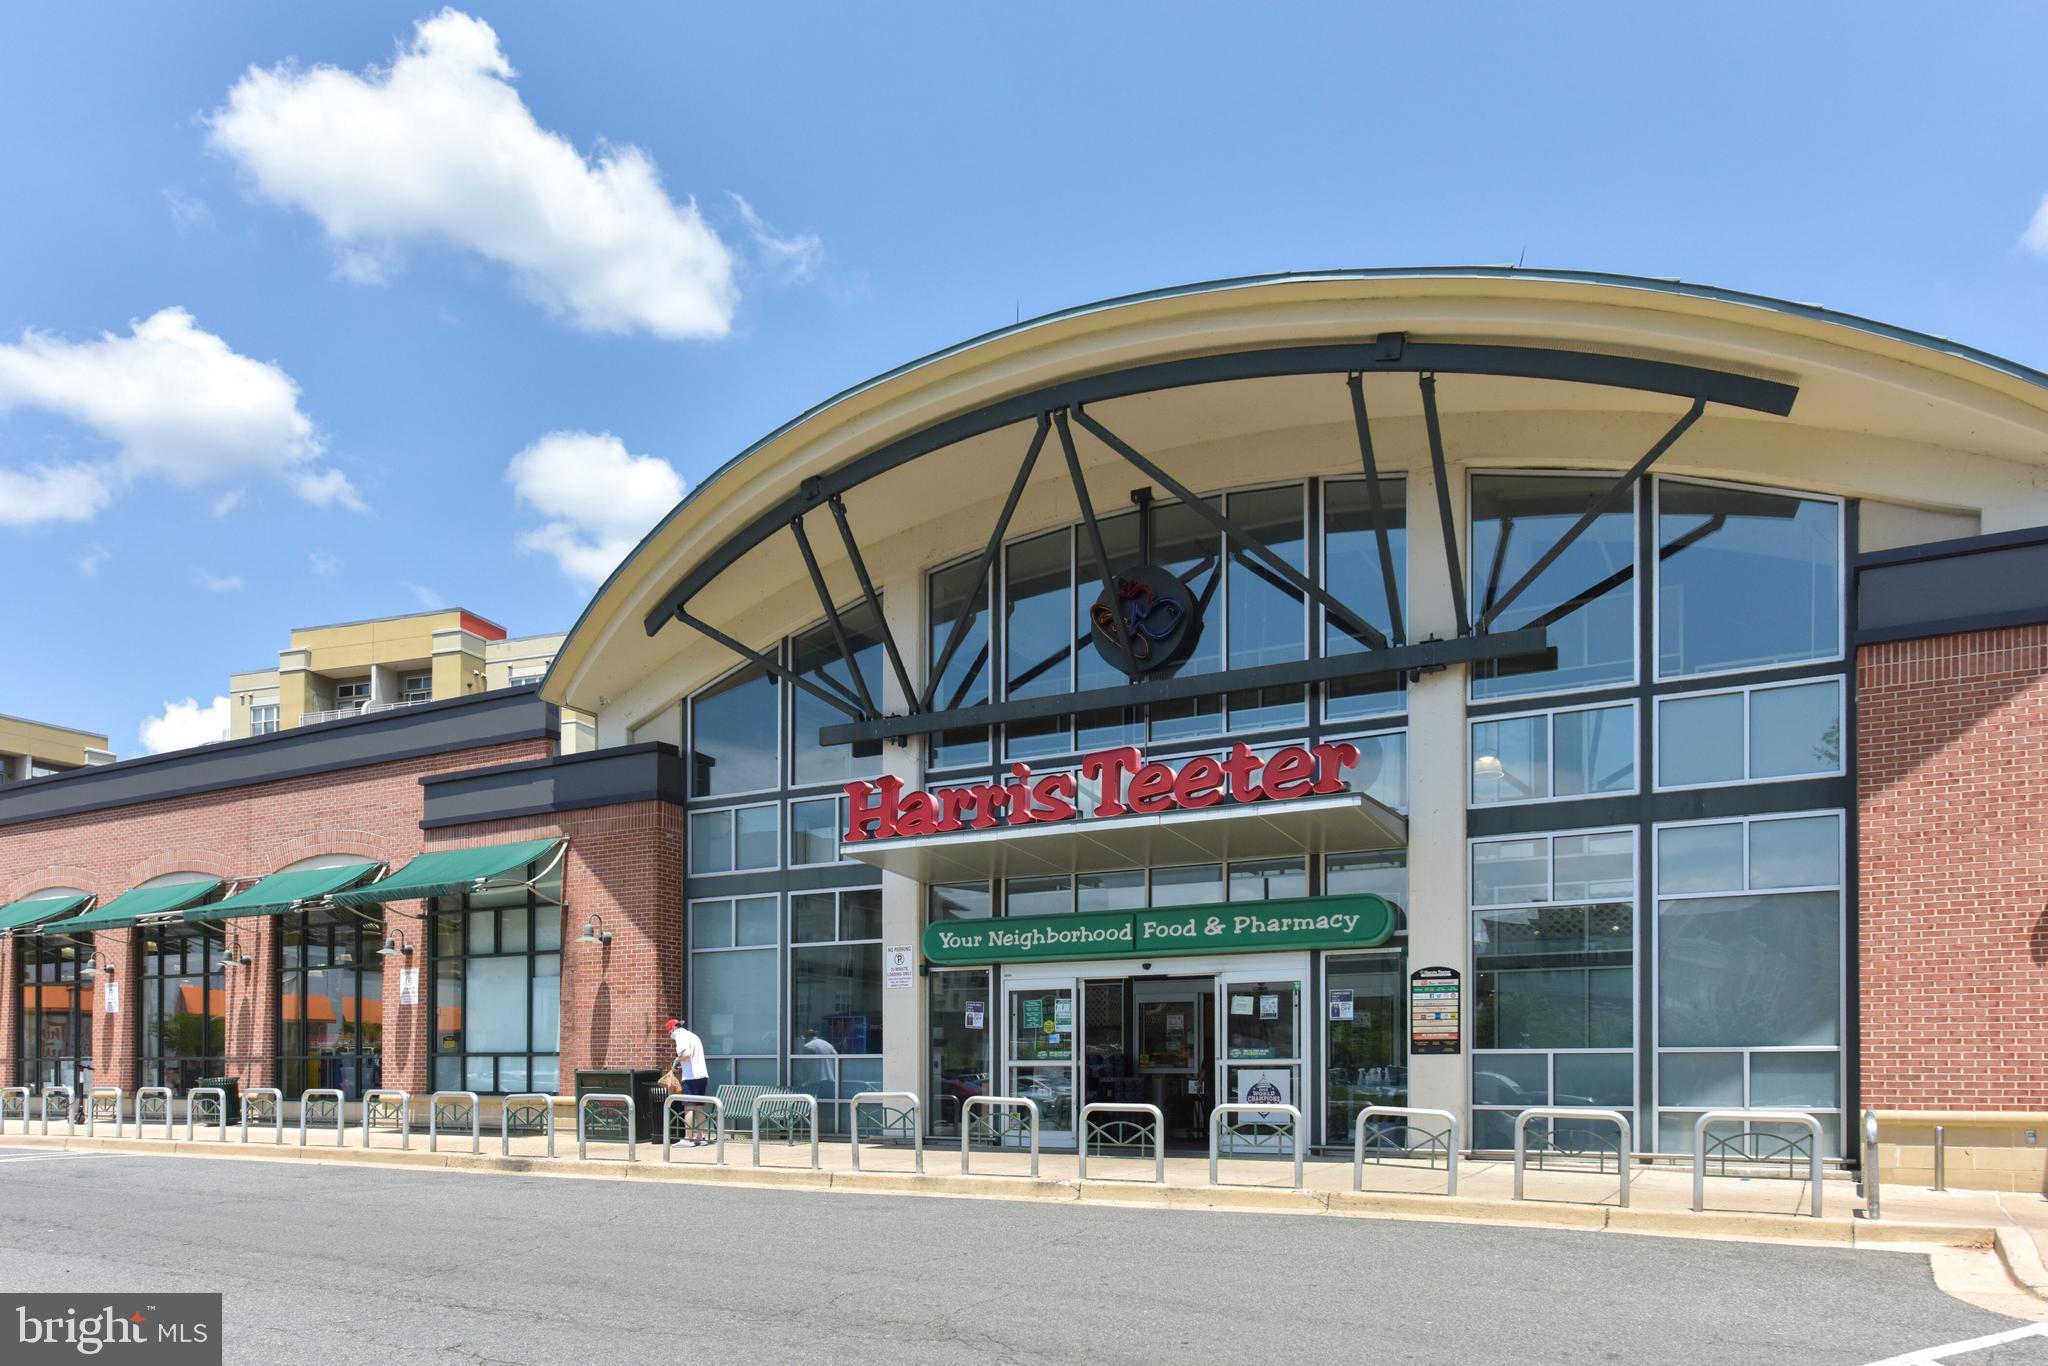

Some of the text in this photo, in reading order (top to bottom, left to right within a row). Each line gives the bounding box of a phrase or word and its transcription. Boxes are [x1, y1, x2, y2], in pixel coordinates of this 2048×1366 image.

[842, 741, 1361, 842] Harris Teeter
[938, 911, 1360, 950] Your Neighborhood Food & Pharmacy
[1247, 1095, 1281, 1103] CHAMPIONS
